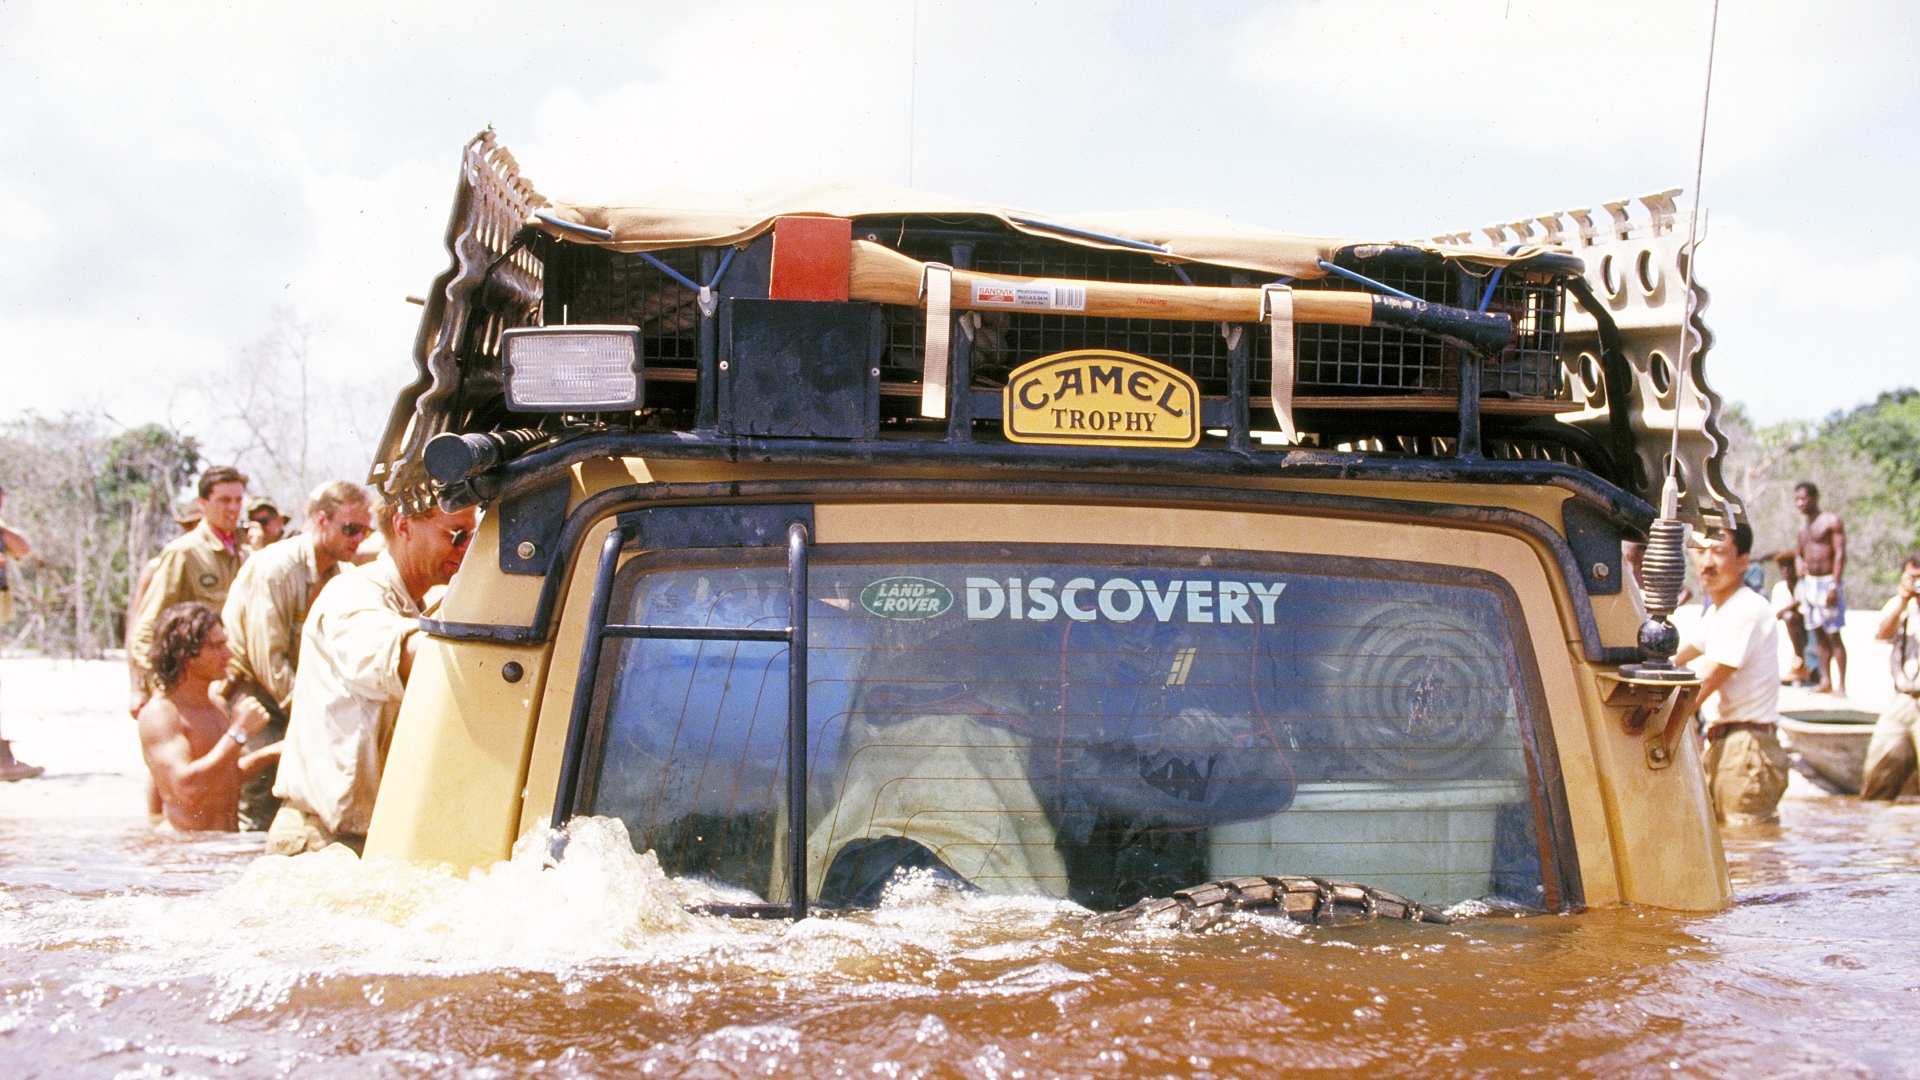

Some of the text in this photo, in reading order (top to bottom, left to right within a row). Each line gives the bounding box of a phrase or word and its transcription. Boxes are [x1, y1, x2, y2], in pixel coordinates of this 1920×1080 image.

[979, 287, 1014, 296] SANDVIK
[1018, 365, 1183, 417] CAMEL
[1051, 408, 1157, 432] TROPHY
[966, 577, 1287, 625] DISCOVERY
